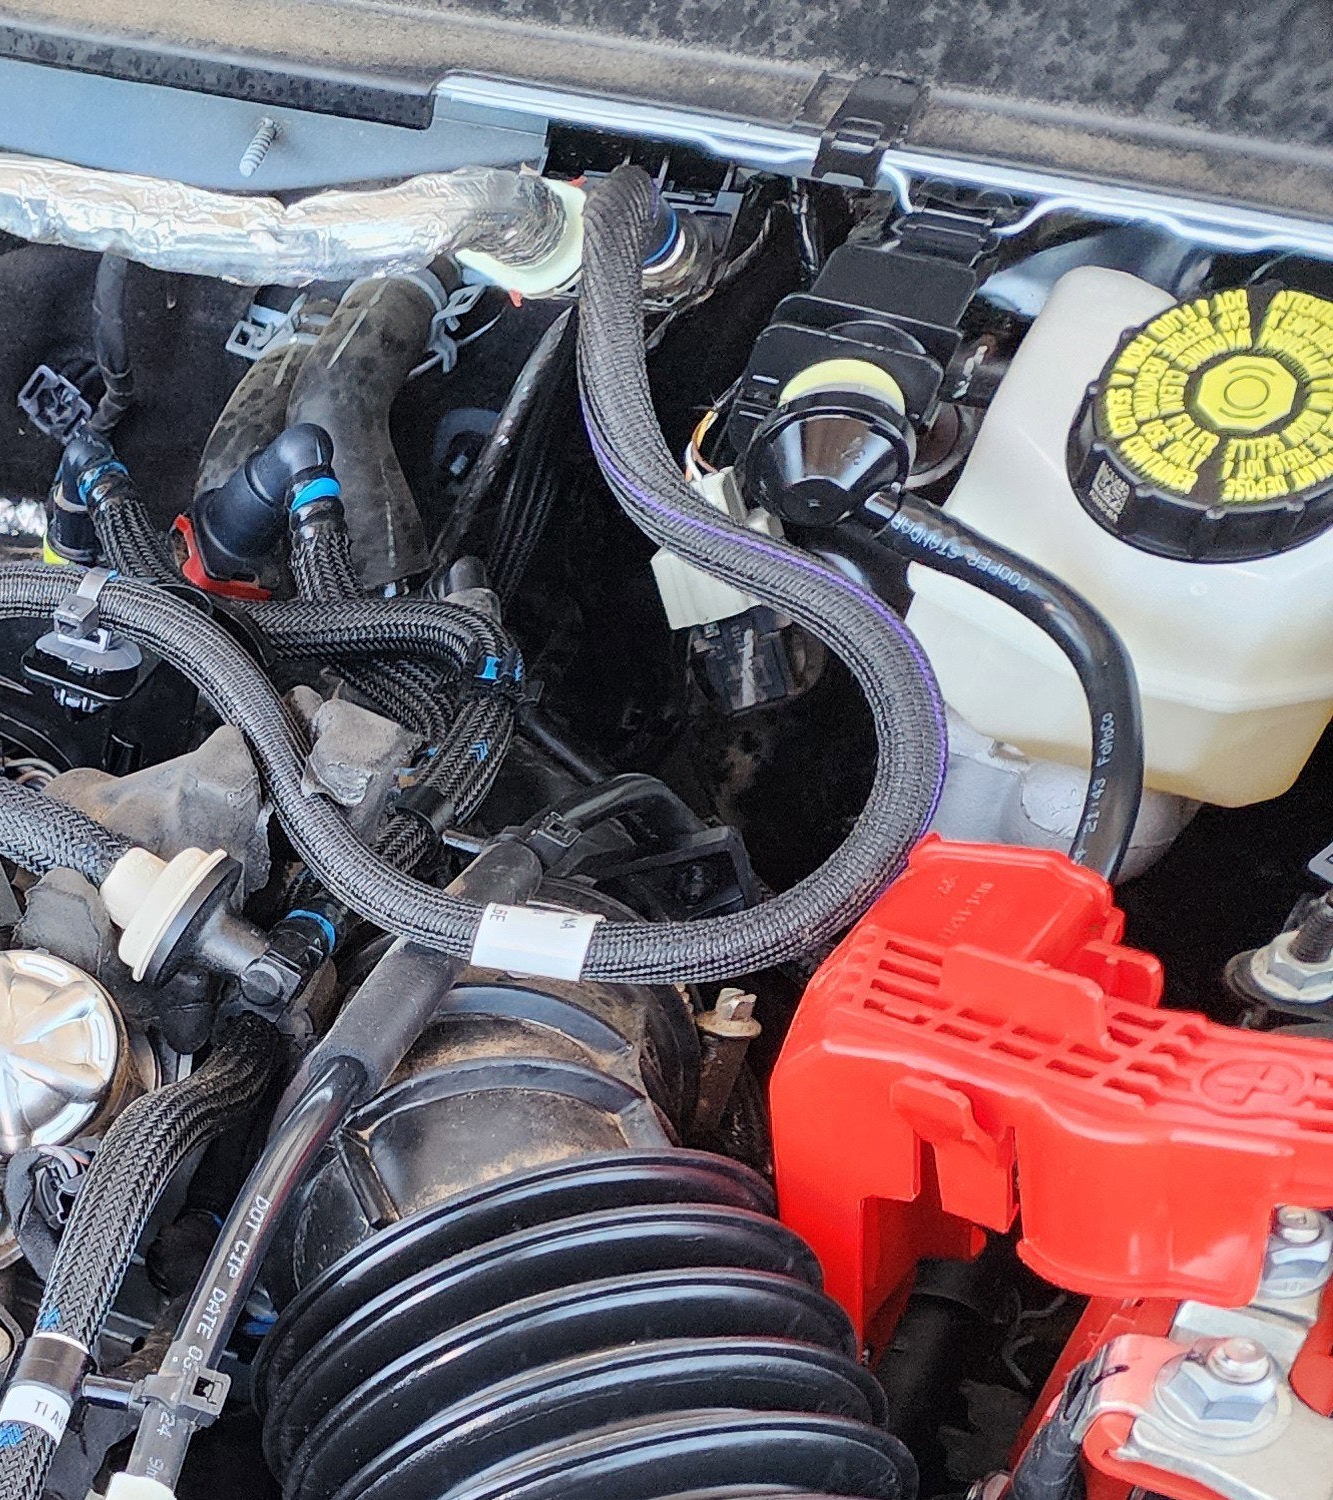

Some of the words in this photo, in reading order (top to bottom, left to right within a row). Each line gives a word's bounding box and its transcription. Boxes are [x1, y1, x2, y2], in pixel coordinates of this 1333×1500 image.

[1146, 305, 1197, 342] FLUID
[1207, 290, 1248, 314] DOT
[1213, 308, 1250, 333] CAP
[1115, 333, 1159, 375] FROM
[1152, 315, 1215, 363] BEFORE
[1172, 325, 1253, 374] WARNING
[1133, 354, 1170, 422] REMOVING
[1158, 367, 1190, 416] CLEAN
[1108, 387, 1140, 439] SEALED
[1137, 418, 1175, 451] USE
[1163, 411, 1222, 456] FILLER
[1119, 438, 1201, 494] CONTAINER
[1159, 439, 1208, 472] ONLY
[1235, 457, 1267, 482] DOT
[888, 510, 1031, 592] COOPER-STANDAR
[1095, 712, 1113, 766] FoMoCo
[224, 1241, 249, 1278] CIP
[195, 1287, 226, 1340] DATE
[156, 1410, 176, 1439] 24
